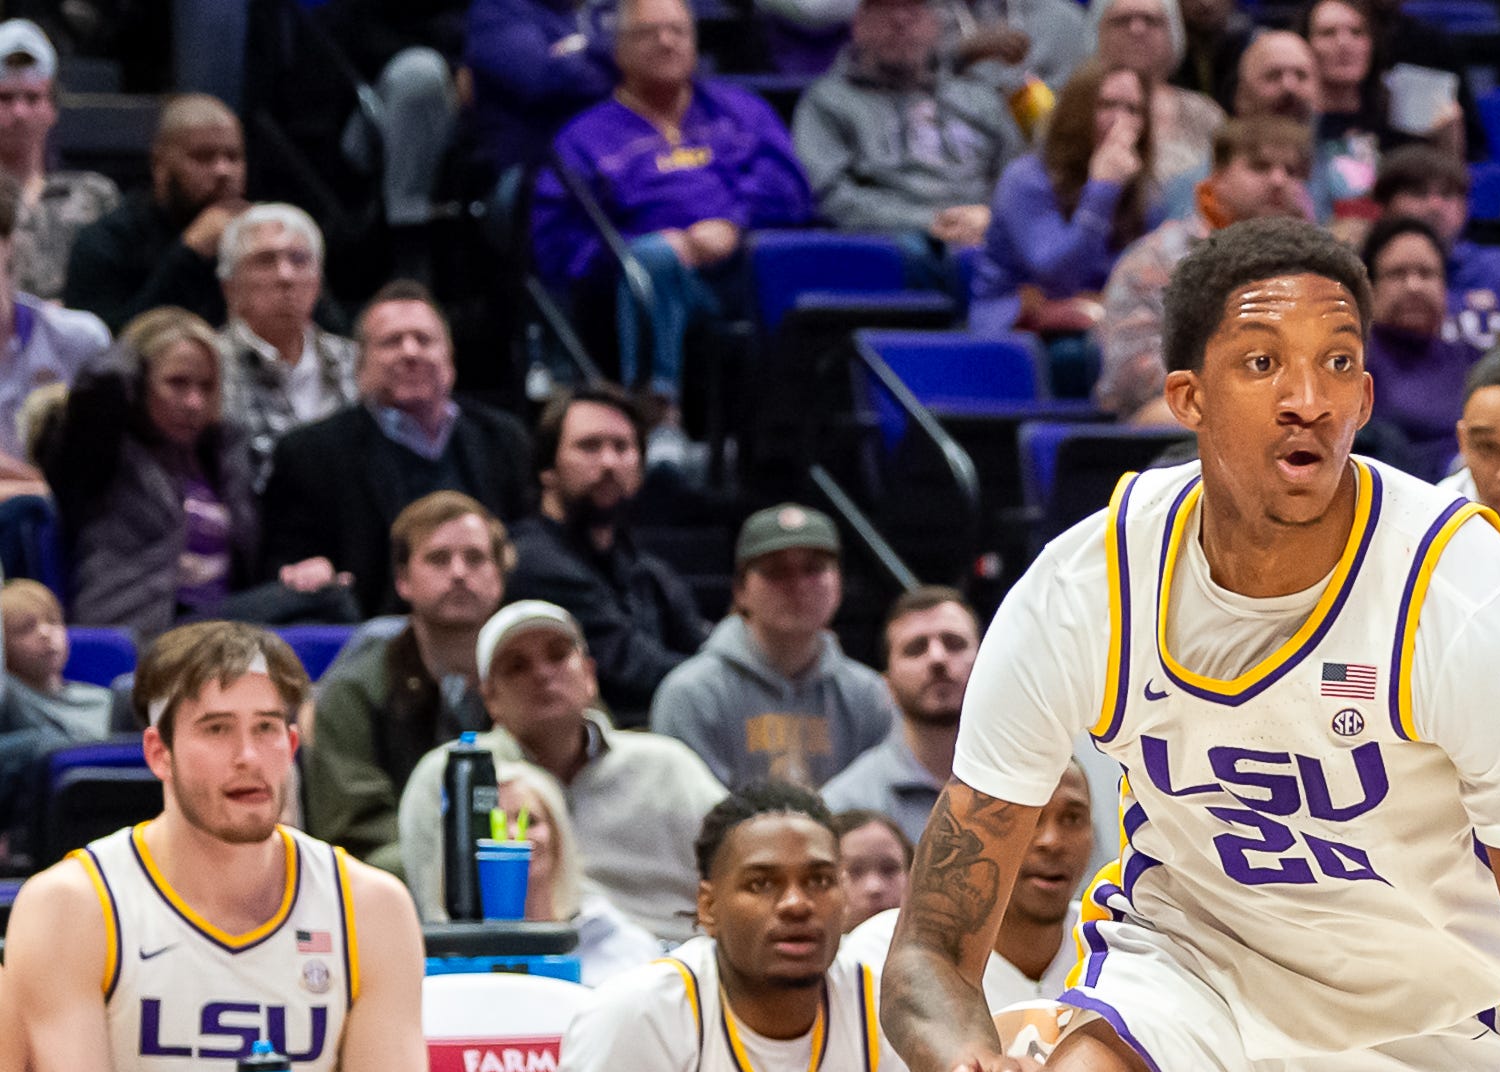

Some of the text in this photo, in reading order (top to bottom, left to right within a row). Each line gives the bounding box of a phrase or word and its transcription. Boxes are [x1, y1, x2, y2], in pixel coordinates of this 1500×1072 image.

[1332, 708, 1365, 736] SEC
[1140, 740, 1390, 822] LSU
[139, 998, 328, 1062] LSU
